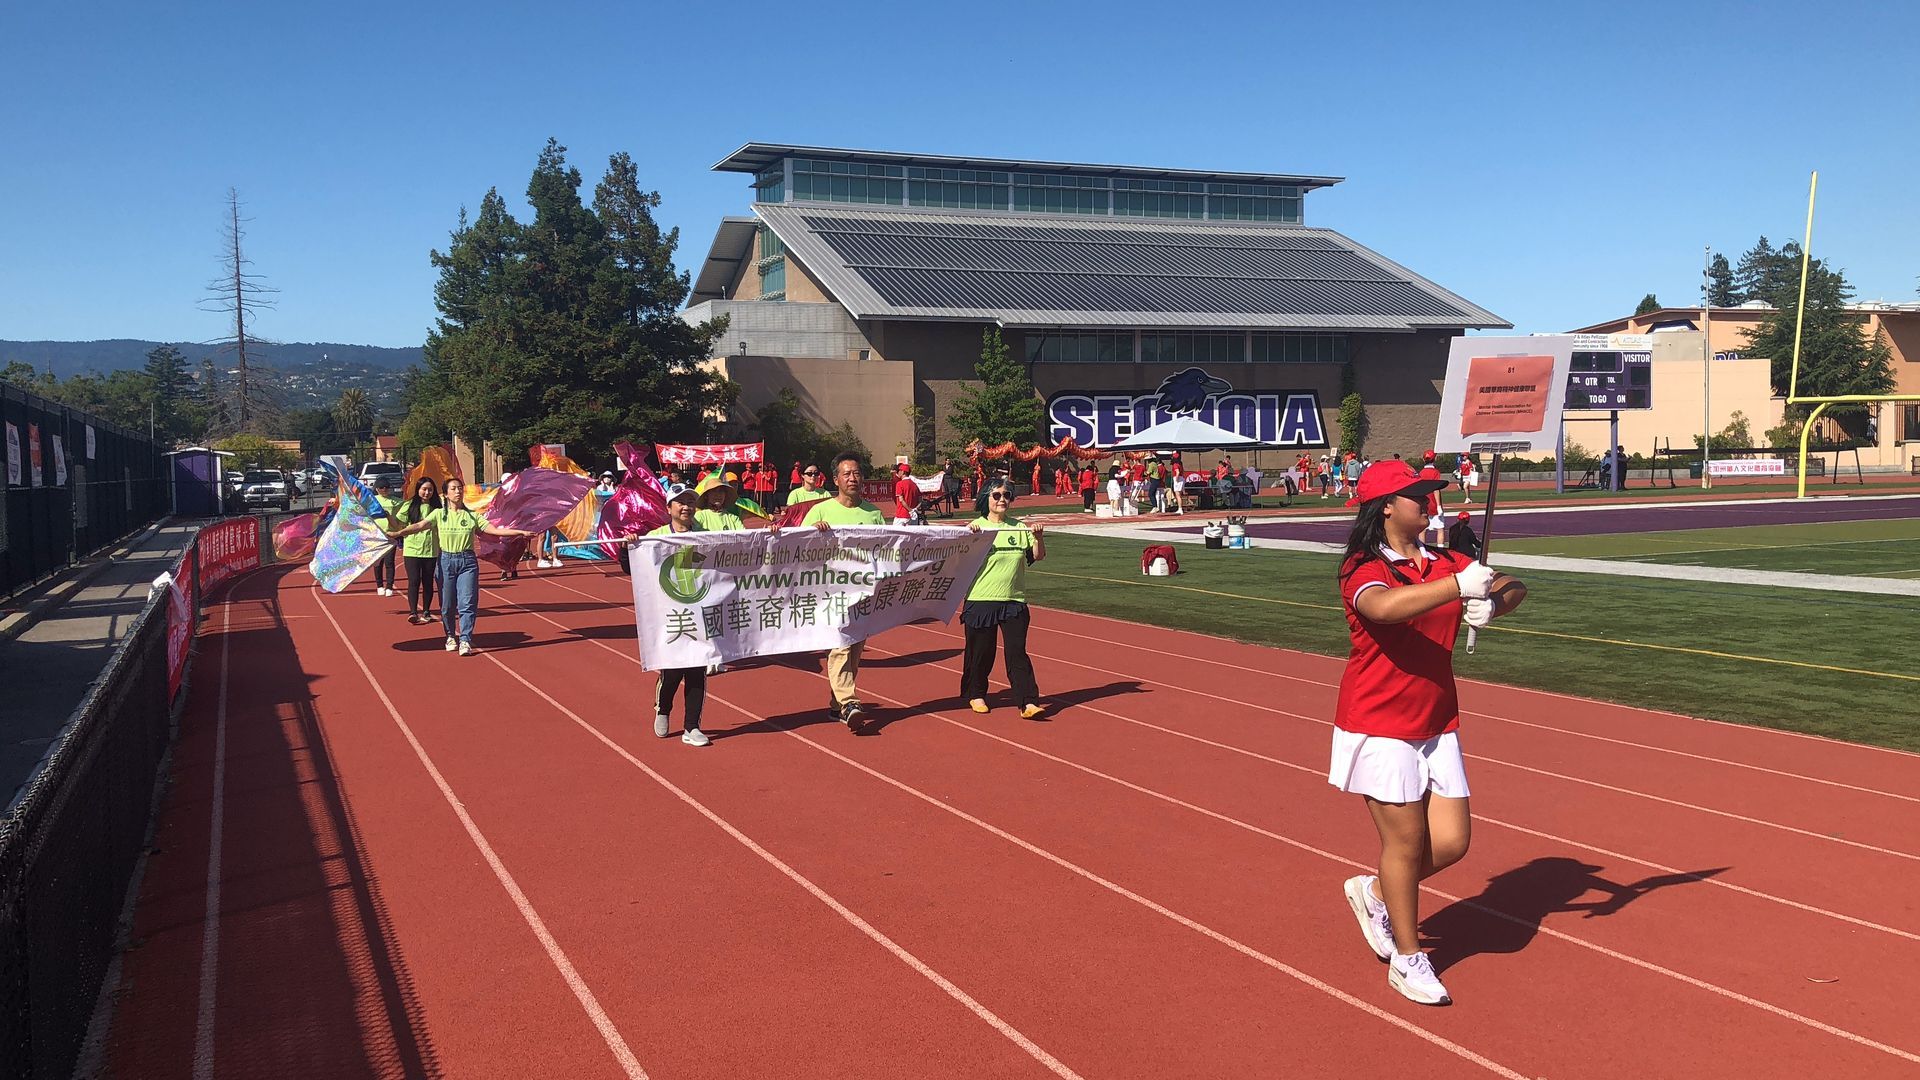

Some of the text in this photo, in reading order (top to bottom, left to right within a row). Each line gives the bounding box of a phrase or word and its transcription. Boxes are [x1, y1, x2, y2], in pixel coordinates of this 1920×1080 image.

[1623, 354, 1650, 363] VISITOR
[1616, 395, 1626, 403] ON
[714, 549, 752, 569] Mental
[755, 546, 791, 565] Health
[793, 544, 854, 563] Association
[856, 543, 870, 562] for
[872, 543, 910, 562] Chinese
[666, 576, 955, 645] 美國華裔精神健康聯盟
